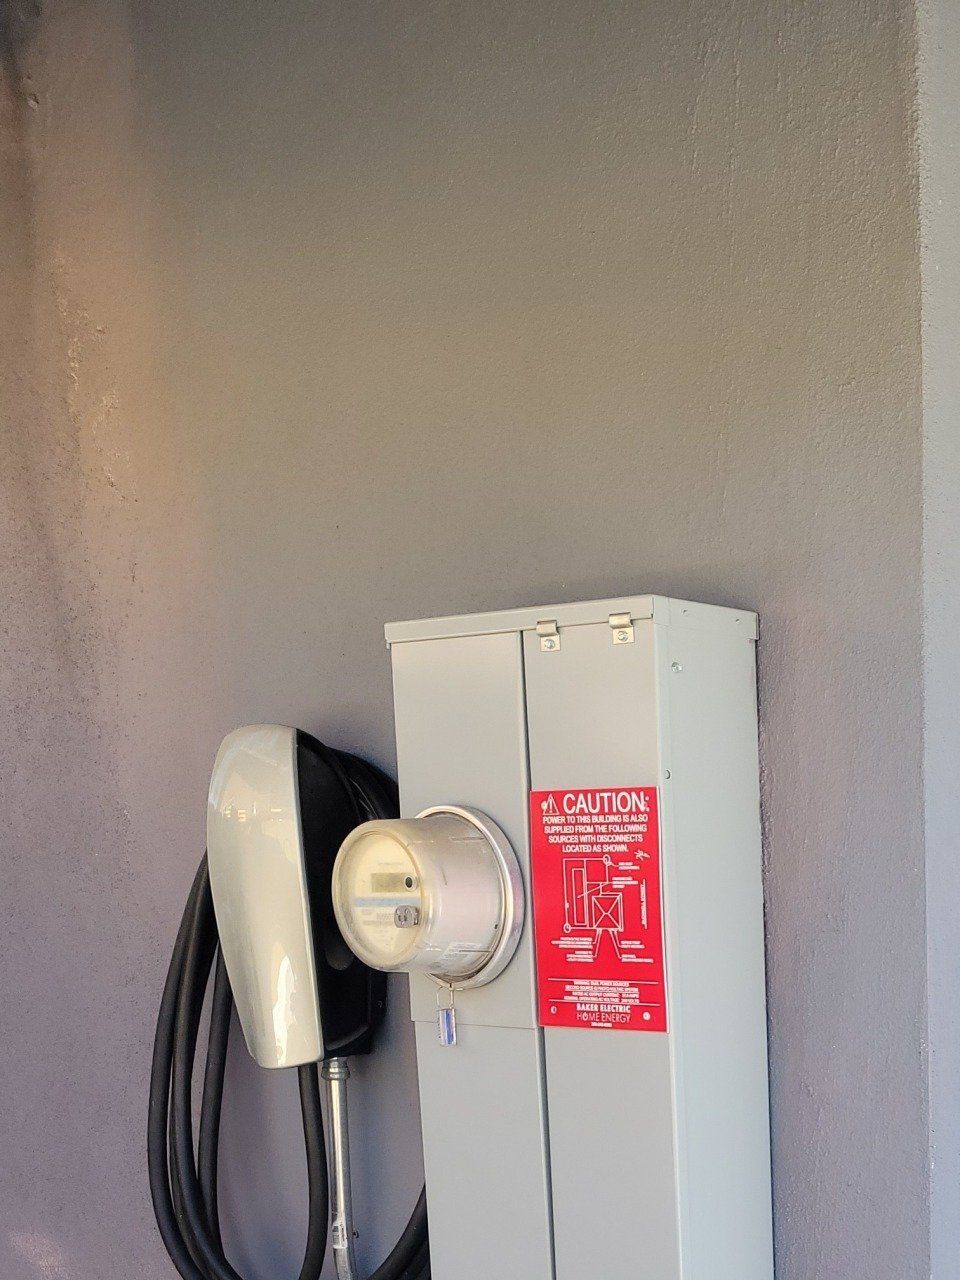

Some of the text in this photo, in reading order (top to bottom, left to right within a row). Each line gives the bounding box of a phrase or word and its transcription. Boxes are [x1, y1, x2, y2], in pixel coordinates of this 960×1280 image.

[543, 814, 648, 824] POWER TO THIS BUILDING IS ALSO
[575, 825, 594, 833] FROM
[609, 824, 647, 832] FOLLOWING
[549, 835, 578, 843] SOURCES
[597, 834, 643, 842] DISCONNECTS
[603, 844, 628, 852] SHOWN.
[576, 1003, 630, 1013] BAKER ELECTRIC
[577, 1012, 630, 1023] HOME ENERGY
